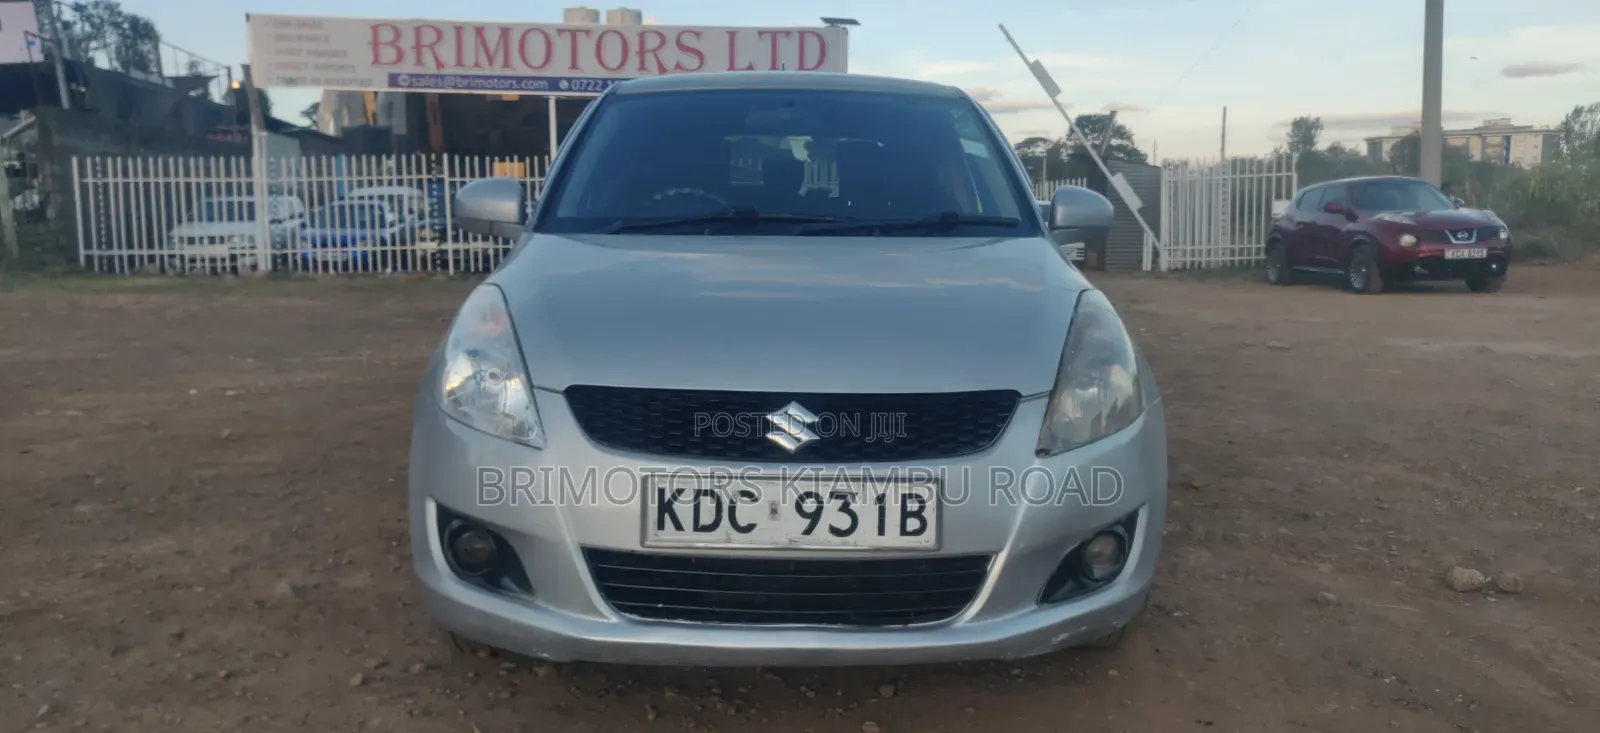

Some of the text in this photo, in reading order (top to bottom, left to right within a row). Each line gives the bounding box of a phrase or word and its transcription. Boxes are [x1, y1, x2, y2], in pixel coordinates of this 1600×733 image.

[369, 23, 827, 74] BRIMOTORS LTD
[411, 76, 549, 91] sales@brimotors.com
[571, 79, 603, 91] 0722
[655, 487, 928, 538] KDC 931B
